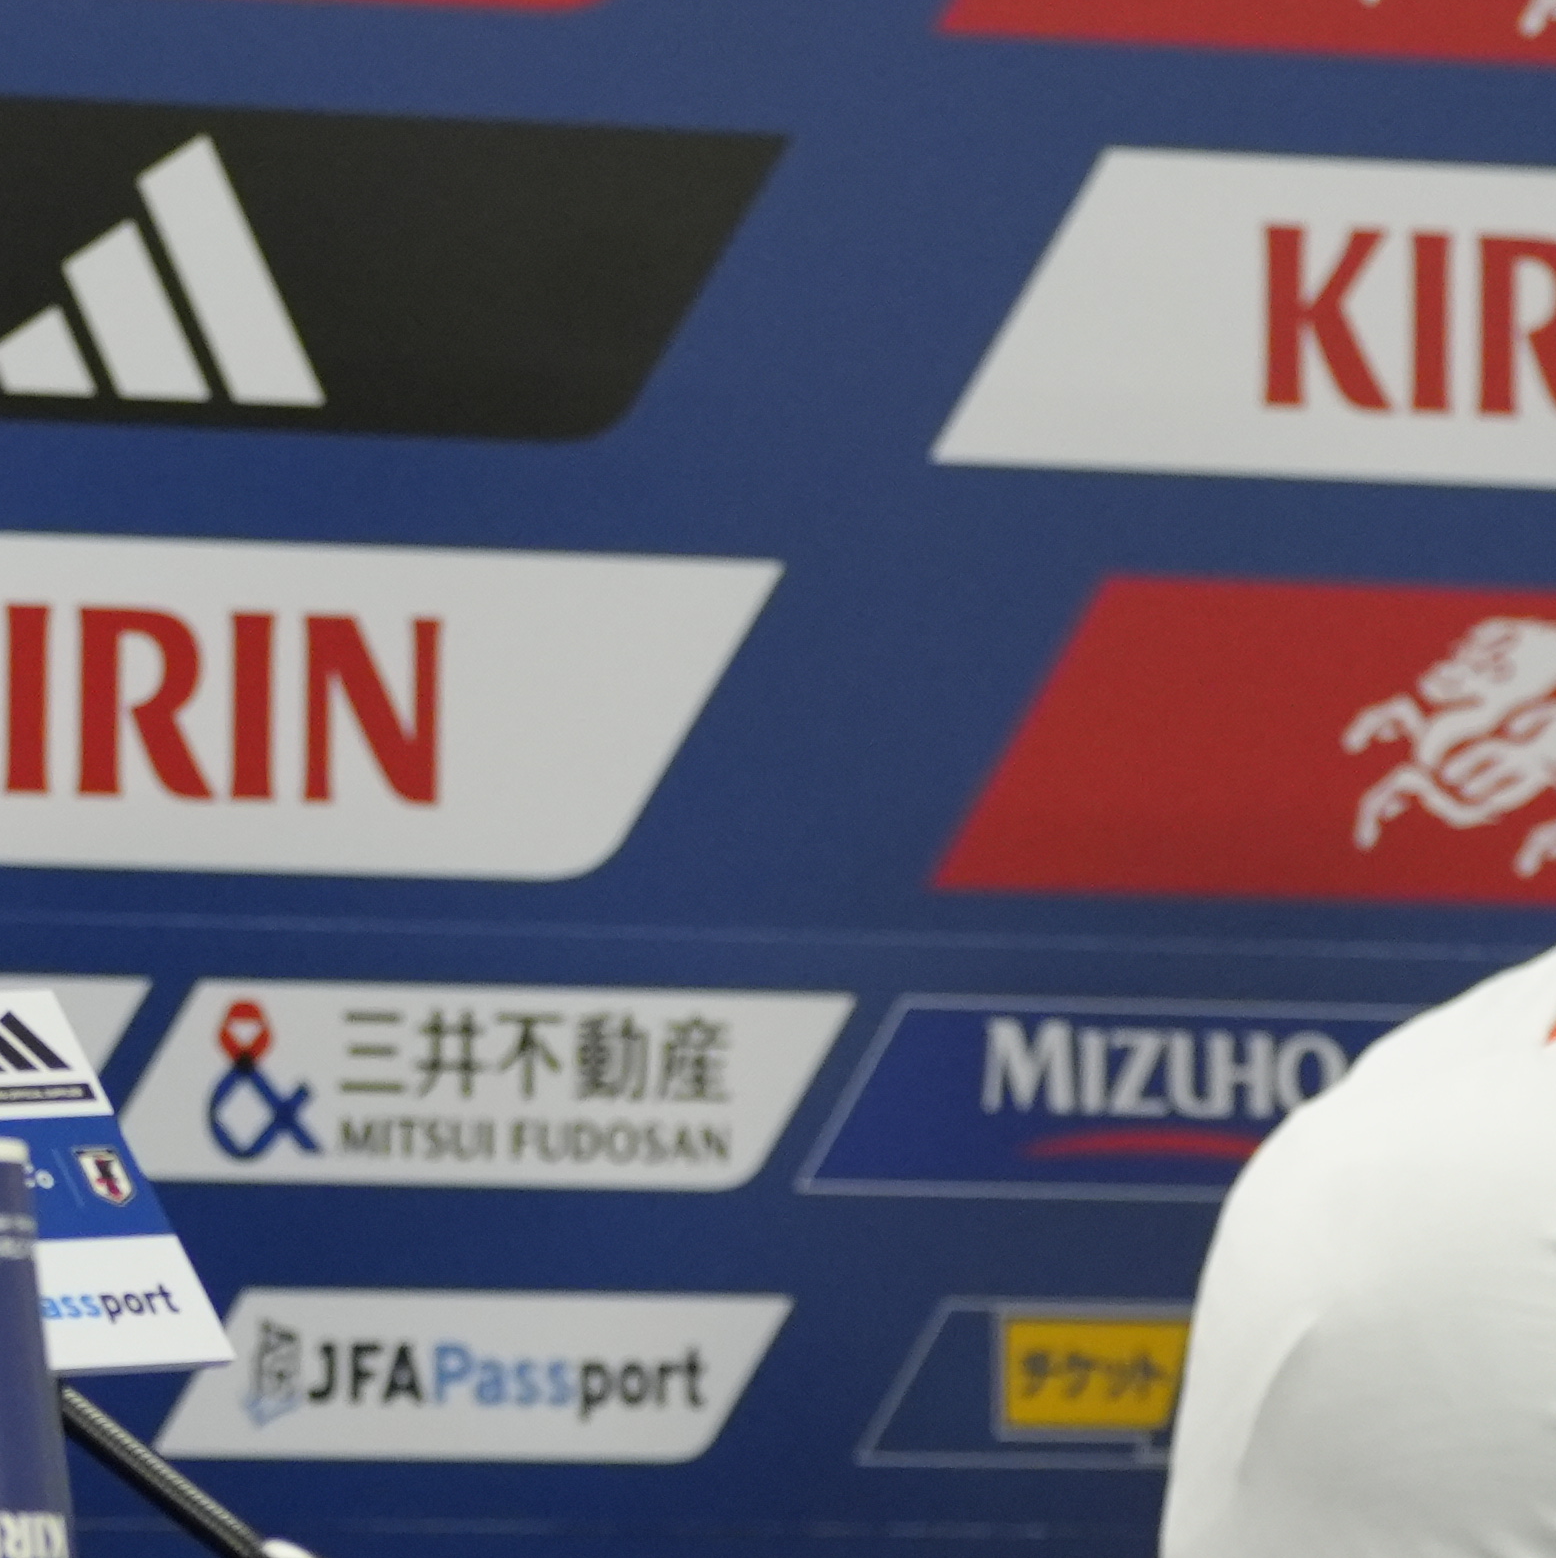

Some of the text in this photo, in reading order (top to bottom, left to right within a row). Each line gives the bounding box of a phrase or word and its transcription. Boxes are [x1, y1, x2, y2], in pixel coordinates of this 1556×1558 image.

[338, 1009, 733, 1102] 三井不動産
[338, 1117, 733, 1163] MITSUI FUDOSAN
